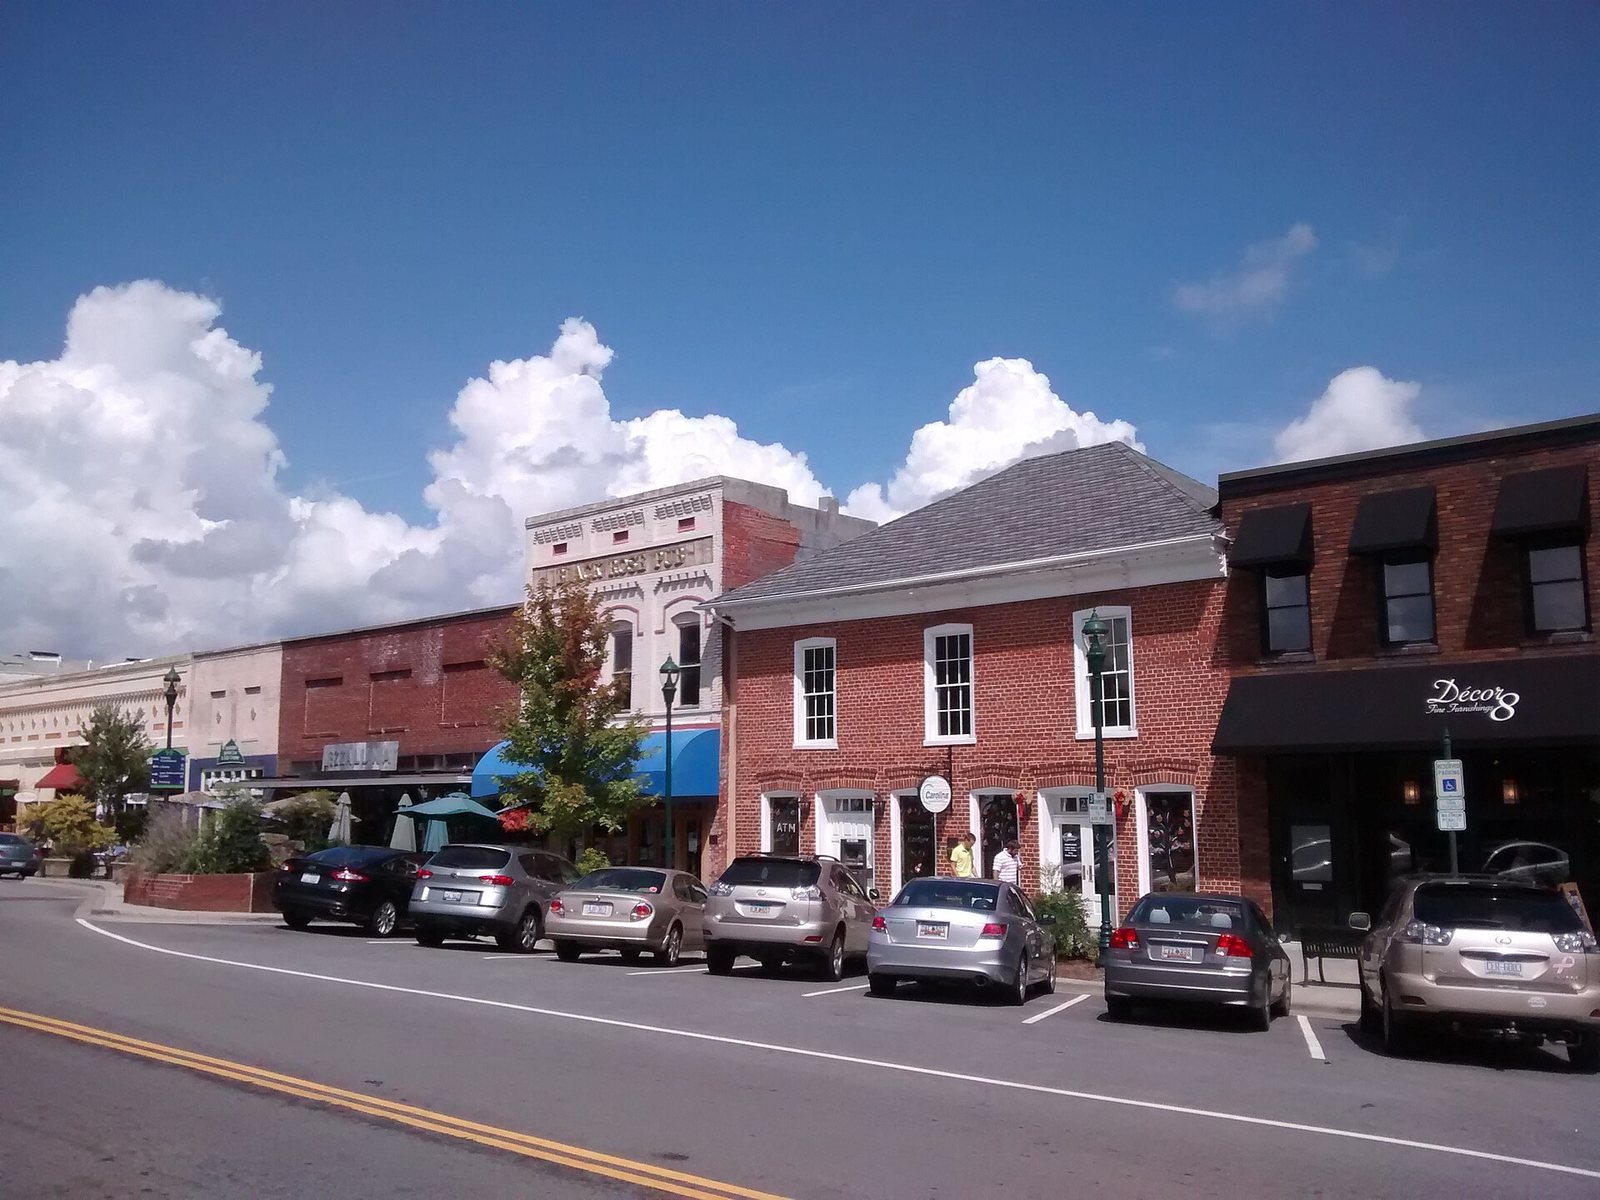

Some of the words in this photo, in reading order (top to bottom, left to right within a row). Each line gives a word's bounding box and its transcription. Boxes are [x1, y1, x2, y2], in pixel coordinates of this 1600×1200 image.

[558, 562, 603, 583] BACK
[655, 548, 686, 570] PUB
[1426, 678, 1504, 704] Décor
[1490, 692, 1520, 721] 8
[1425, 704, 1446, 714] Fine
[1446, 702, 1495, 713] Furnishings
[925, 790, 949, 800] Carolina
[776, 822, 796, 833] ATM
